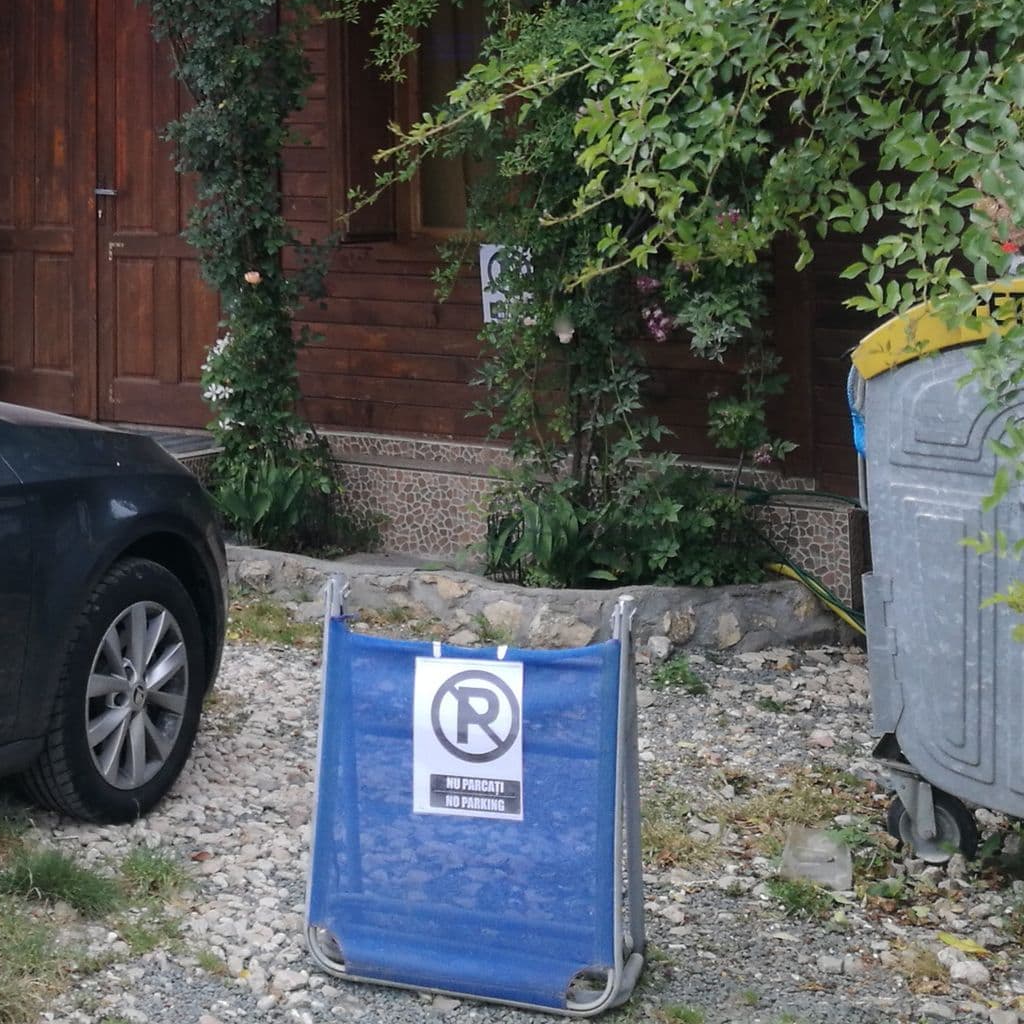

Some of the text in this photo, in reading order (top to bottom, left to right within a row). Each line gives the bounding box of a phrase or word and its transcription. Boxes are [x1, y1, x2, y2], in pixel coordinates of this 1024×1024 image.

[446, 777, 461, 790] NU
[445, 795, 505, 812] NO PARKING
